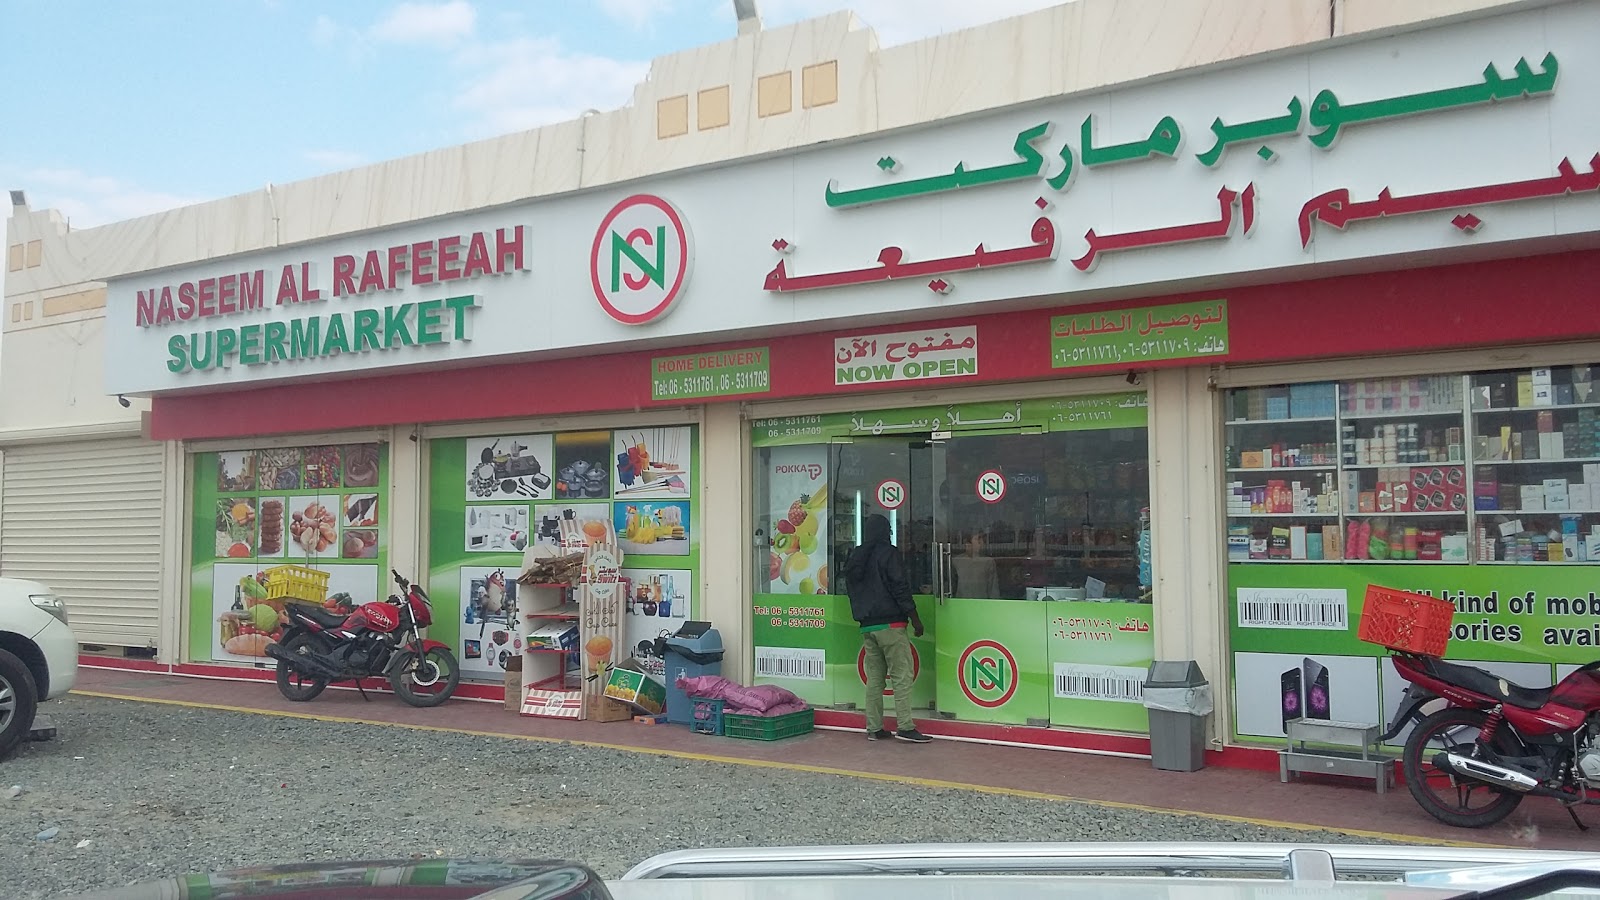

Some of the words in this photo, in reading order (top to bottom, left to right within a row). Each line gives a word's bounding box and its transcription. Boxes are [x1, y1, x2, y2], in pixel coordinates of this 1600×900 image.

[1196, 50, 1560, 168] سوبر
[824, 112, 1184, 210] ماركت
[136, 269, 269, 328] NASEEM
[275, 261, 326, 305] AL
[332, 225, 531, 297] RAFEEAH
[1054, 312, 1132, 341] الطلبات
[1138, 304, 1224, 336] لتوصيل
[166, 294, 481, 373] SUPERMARKET
[885, 332, 975, 363] مفتوح
[657, 358, 694, 373] HOME
[698, 351, 763, 369] DELIVERY
[837, 364, 895, 383] NOW
[903, 358, 975, 378] OPEN
[654, 380, 668, 396] Tel:
[669, 379, 678, 395] 06
[684, 375, 714, 393] 5311761
[720, 374, 730, 390] 06
[736, 370, 768, 389] 5311709
[752, 419, 767, 428] Tel:
[768, 418, 779, 427] 06
[785, 415, 821, 426] 5311761
[768, 430, 779, 438] 06
[785, 427, 822, 437] 5311709
[775, 464, 807, 474] POKKA
[754, 606, 769, 615] Tel:
[771, 606, 782, 616] 06
[788, 607, 825, 617] 5311761
[1509, 591, 1536, 614] of
[1547, 592, 1600, 615] mob
[771, 617, 782, 627] 06
[788, 618, 826, 628] 5311709
[1544, 623, 1600, 645] avai
